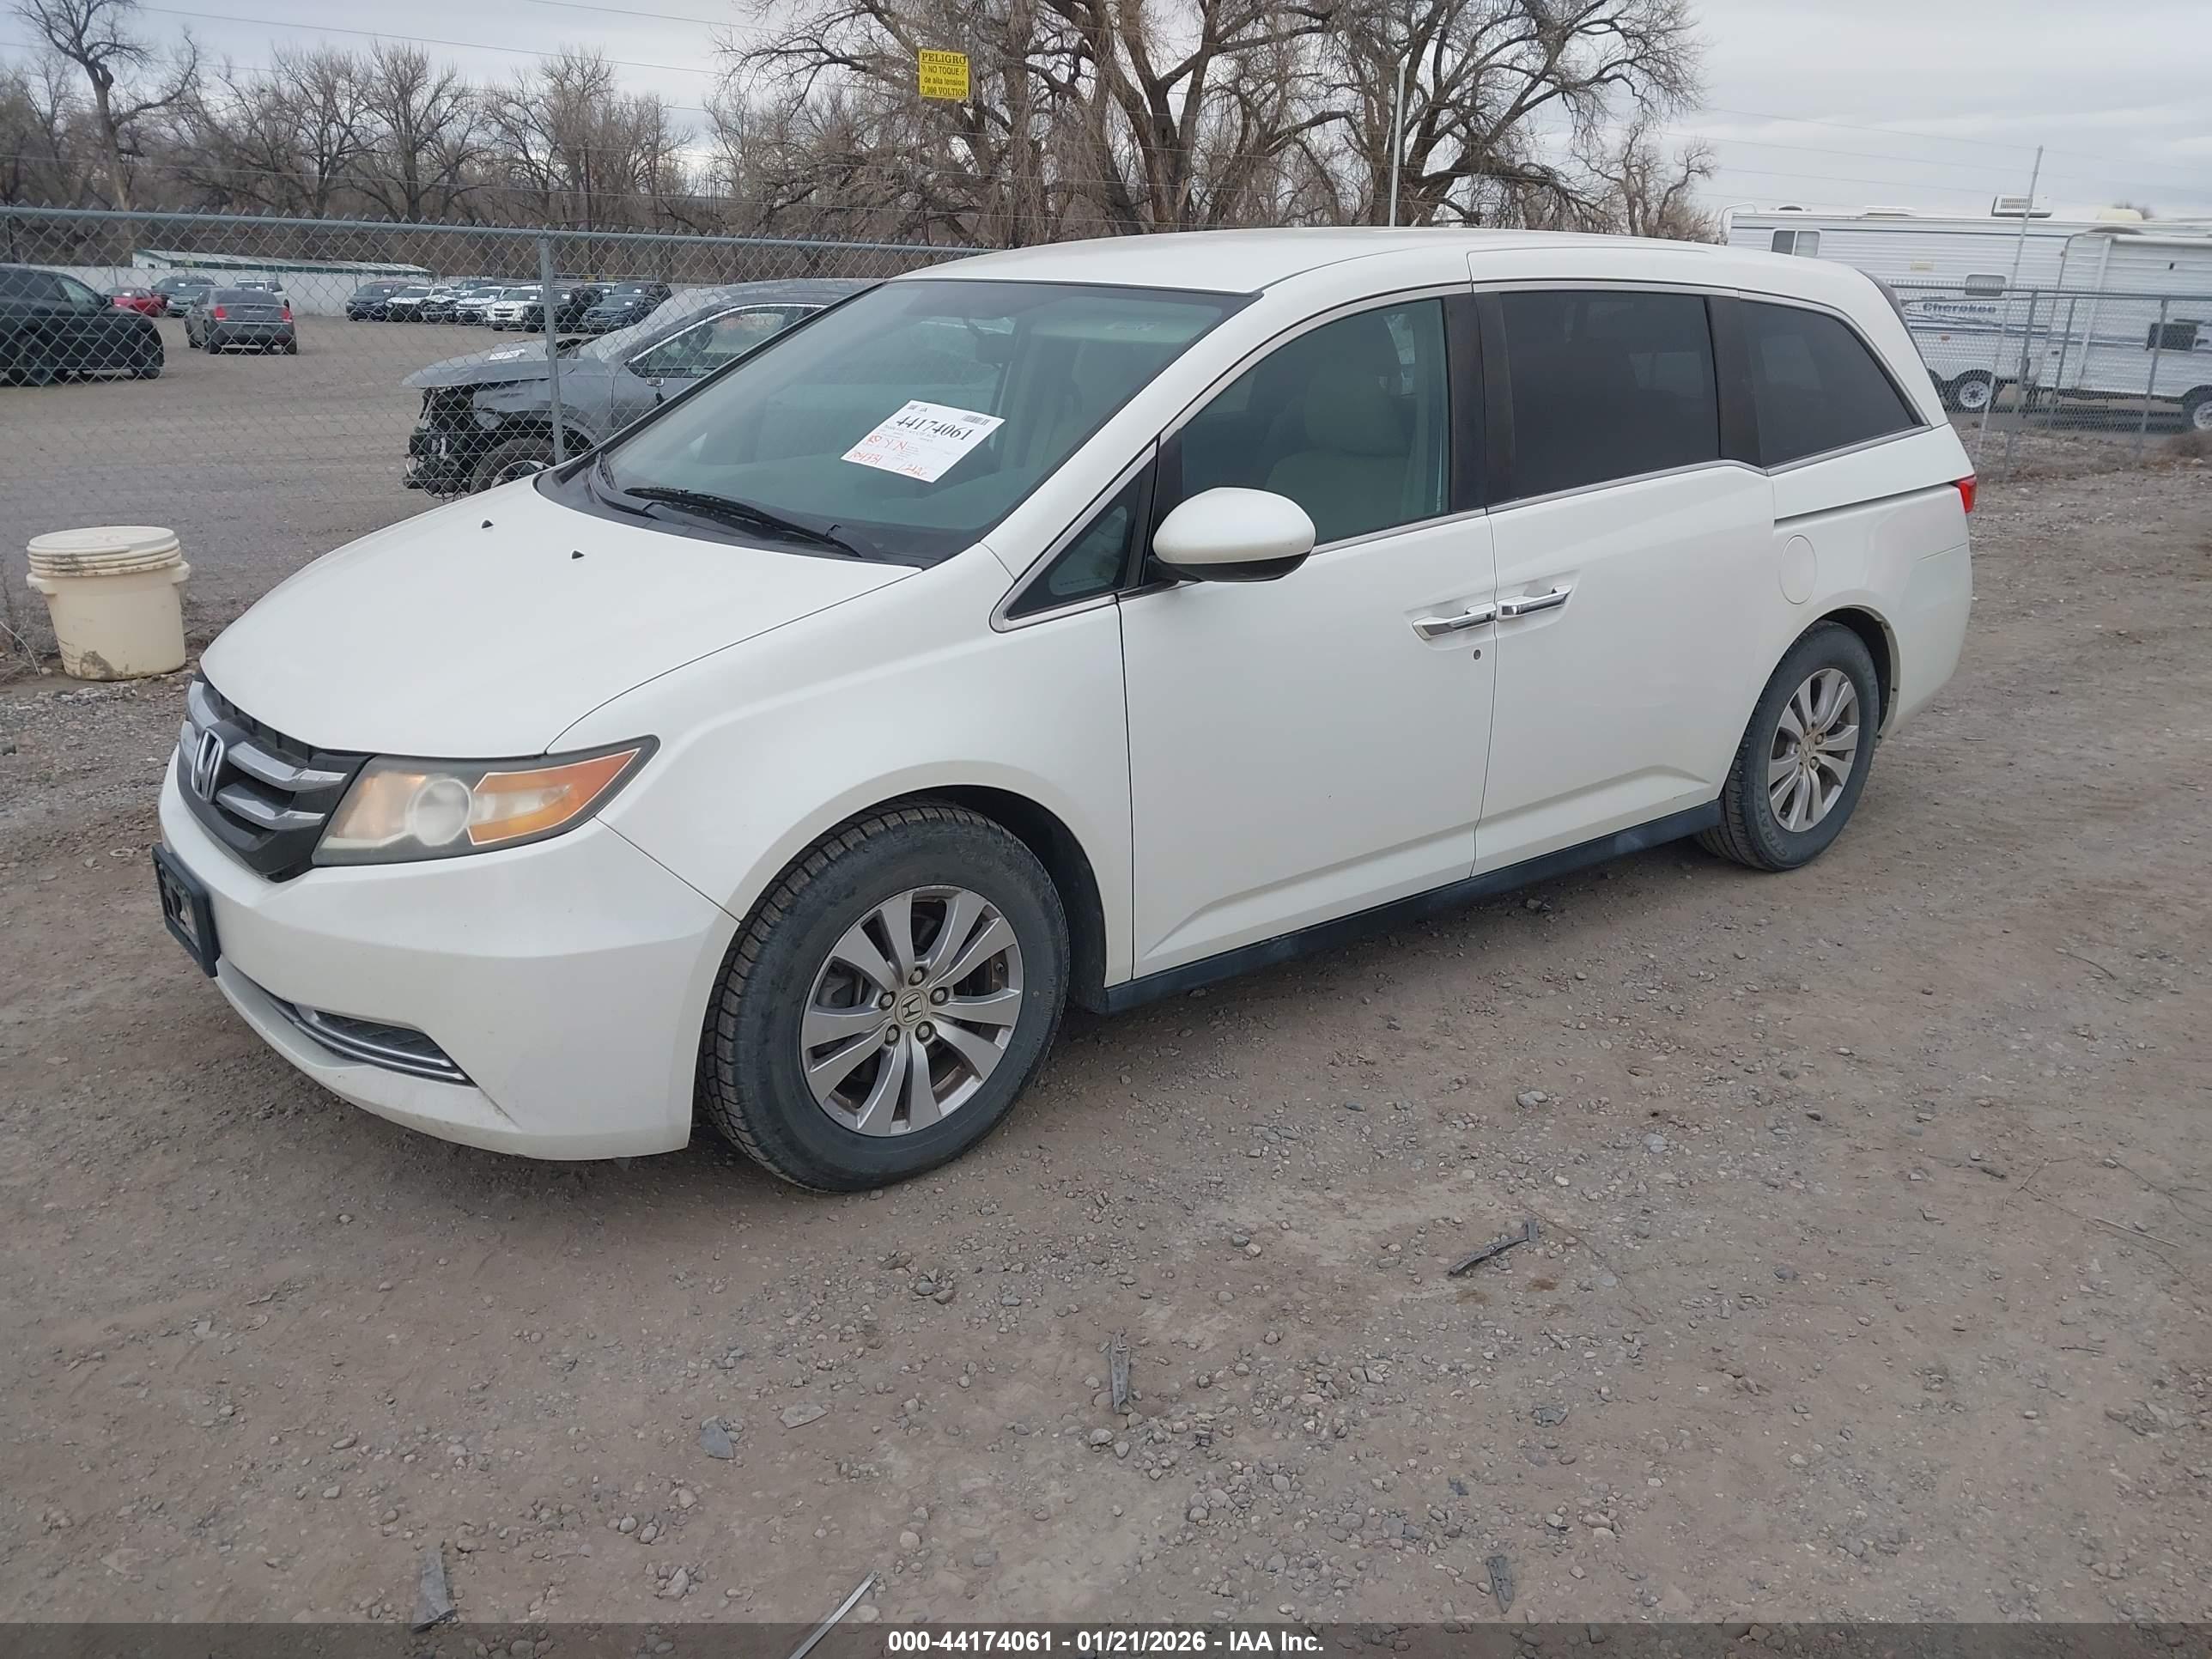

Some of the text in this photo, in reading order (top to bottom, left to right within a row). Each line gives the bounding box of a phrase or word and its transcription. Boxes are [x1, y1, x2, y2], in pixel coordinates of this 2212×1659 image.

[921, 52, 966, 65] PELIGRO
[928, 65, 960, 76] NO TOQUE
[924, 76, 932, 84] de
[939, 87, 967, 97] VOLTIOS
[1923, 302, 1996, 313] Cherokee
[896, 416, 975, 441] 44174061
